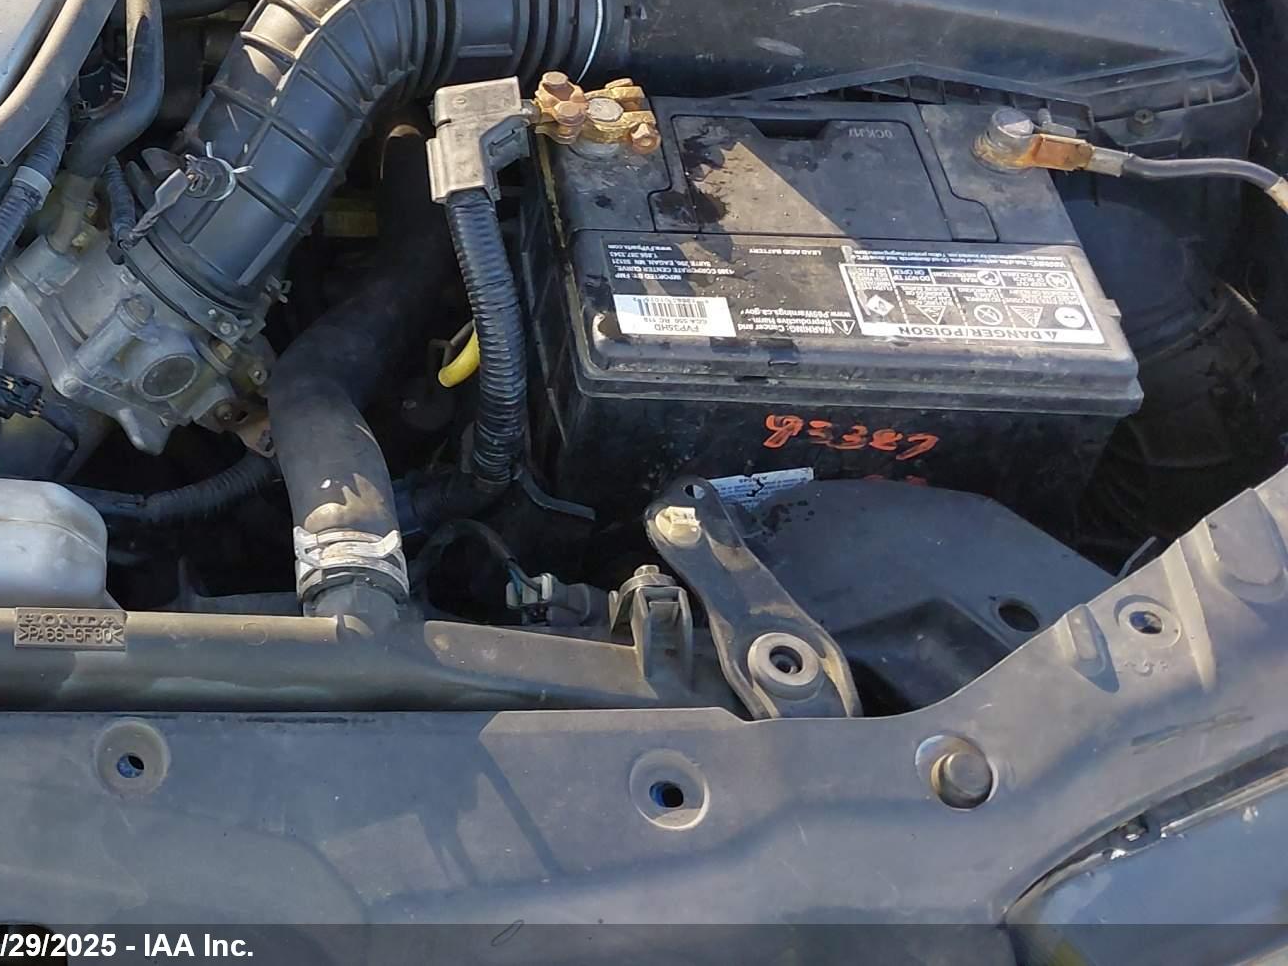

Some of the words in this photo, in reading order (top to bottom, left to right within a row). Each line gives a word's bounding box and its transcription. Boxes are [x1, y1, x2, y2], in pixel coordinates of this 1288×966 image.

[776, 317, 832, 327] Reproductive
[737, 323, 754, 331] and
[755, 323, 786, 332] Cancer
